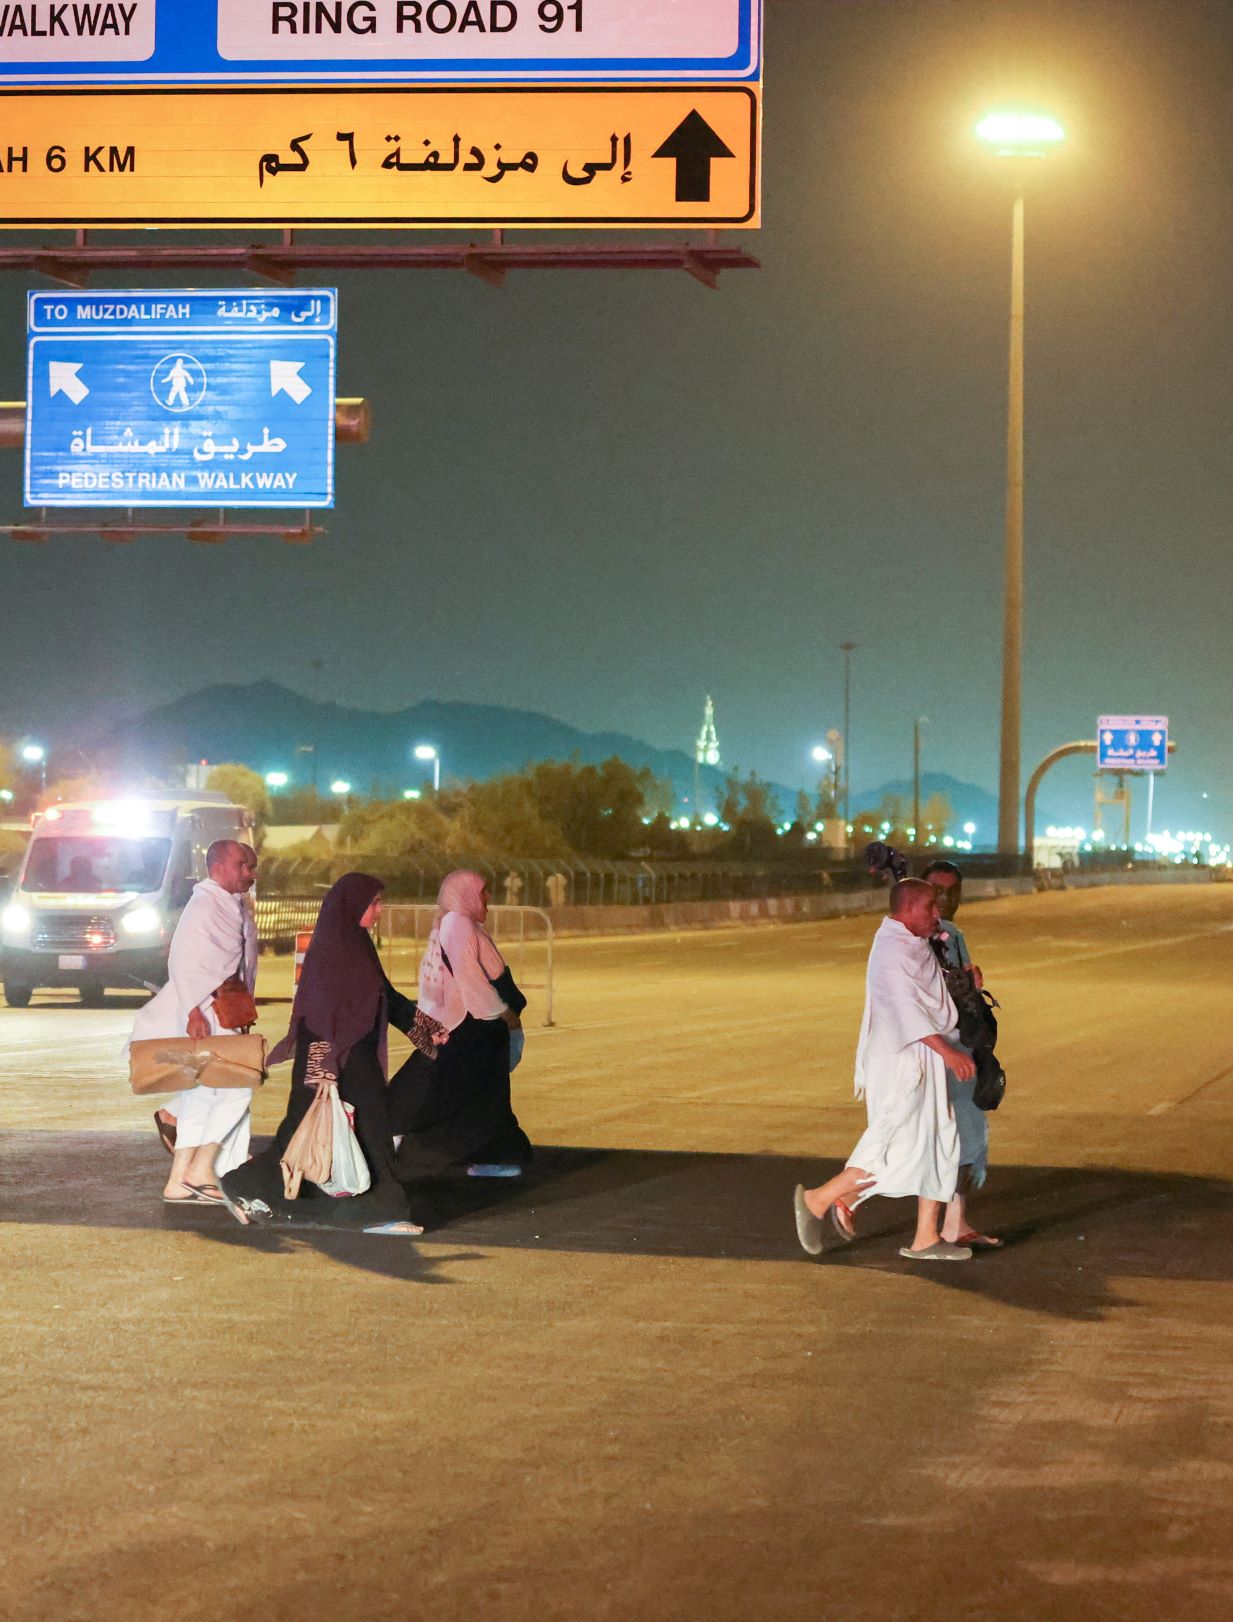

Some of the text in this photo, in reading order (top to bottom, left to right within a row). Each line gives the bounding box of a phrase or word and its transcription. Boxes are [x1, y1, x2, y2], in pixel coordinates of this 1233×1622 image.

[271, 0, 584, 35] RING ROAD 91
[45, 145, 67, 173] 6
[83, 145, 135, 173] KM
[258, 131, 633, 188] إلى مزدلفة ٦ كم
[44, 304, 190, 320] TO MUZDALIFAH
[217, 300, 321, 322] إلى مزدلفة
[70, 425, 287, 461] طريق المشاة
[58, 472, 298, 489] PEDESTRIAN WALKWAY
